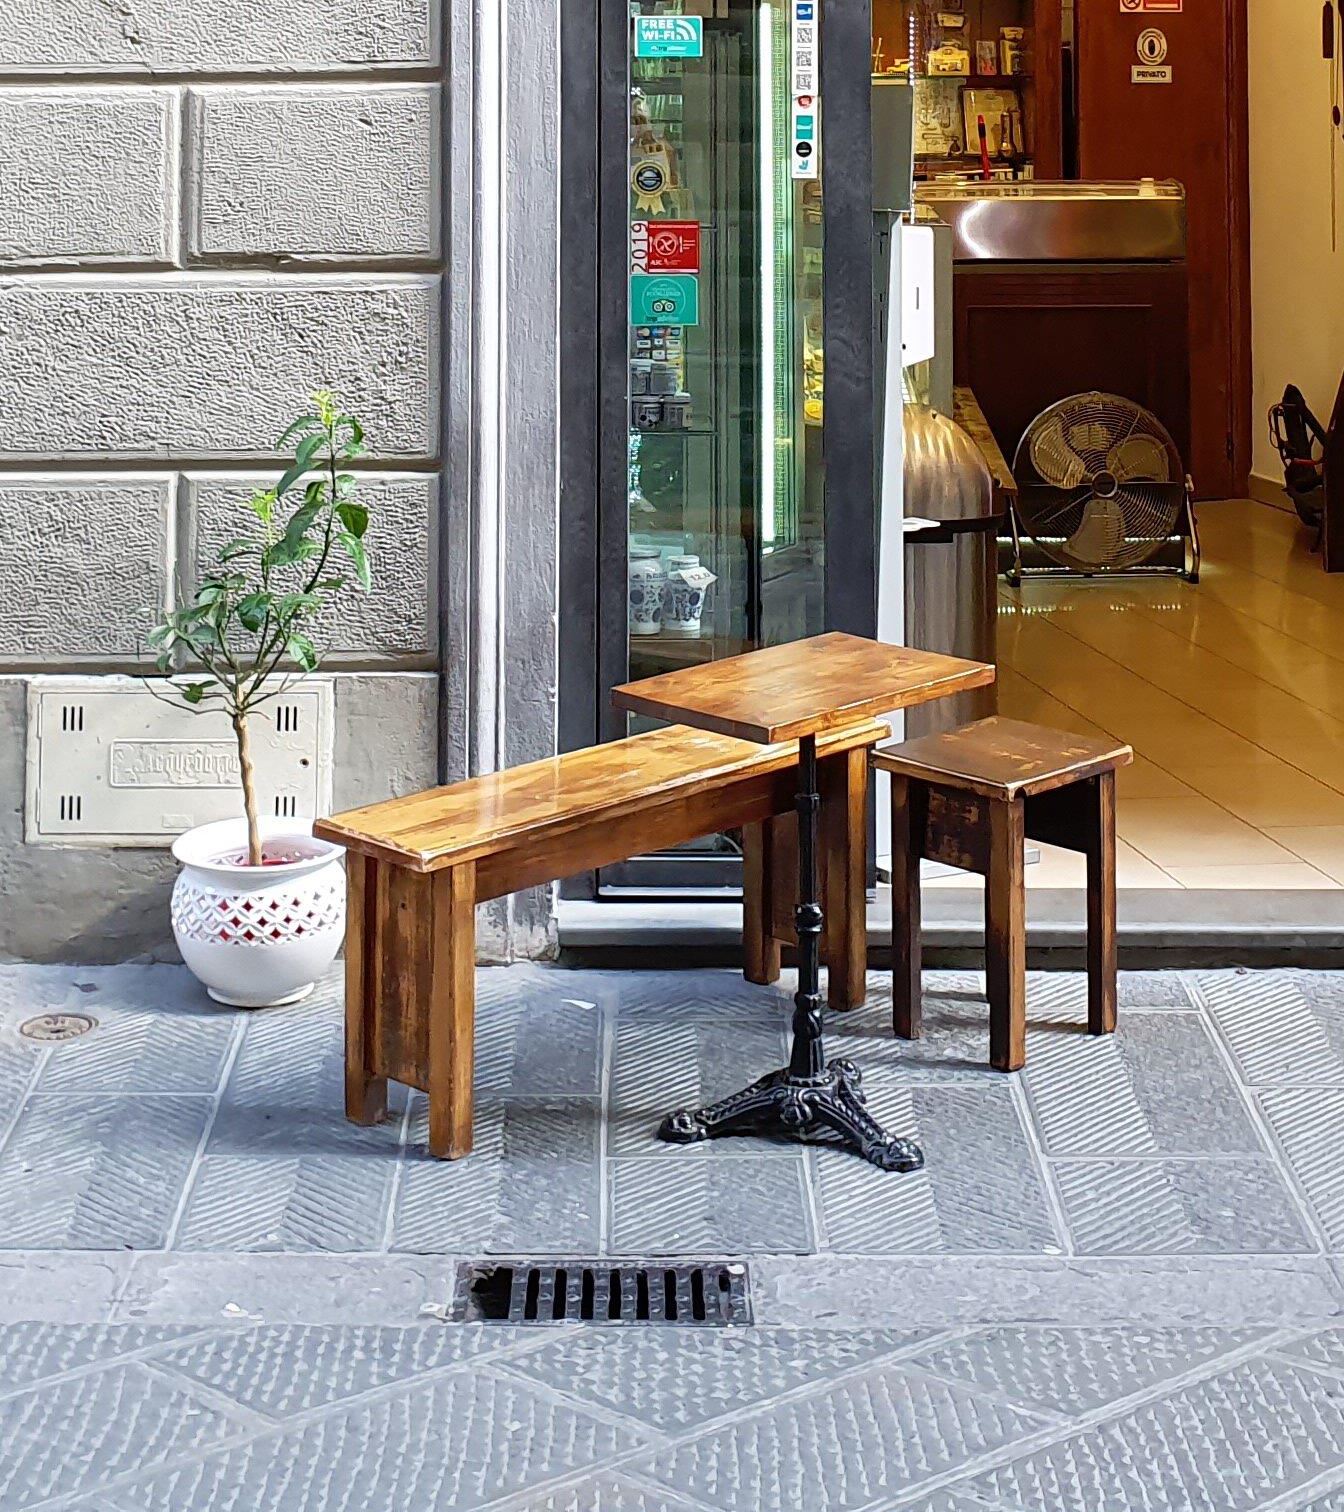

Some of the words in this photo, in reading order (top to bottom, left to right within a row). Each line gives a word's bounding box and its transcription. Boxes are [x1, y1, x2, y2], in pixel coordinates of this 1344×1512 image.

[641, 19, 675, 30] FREE
[641, 30, 676, 41] WI-FI
[631, 222, 648, 274] 2019
